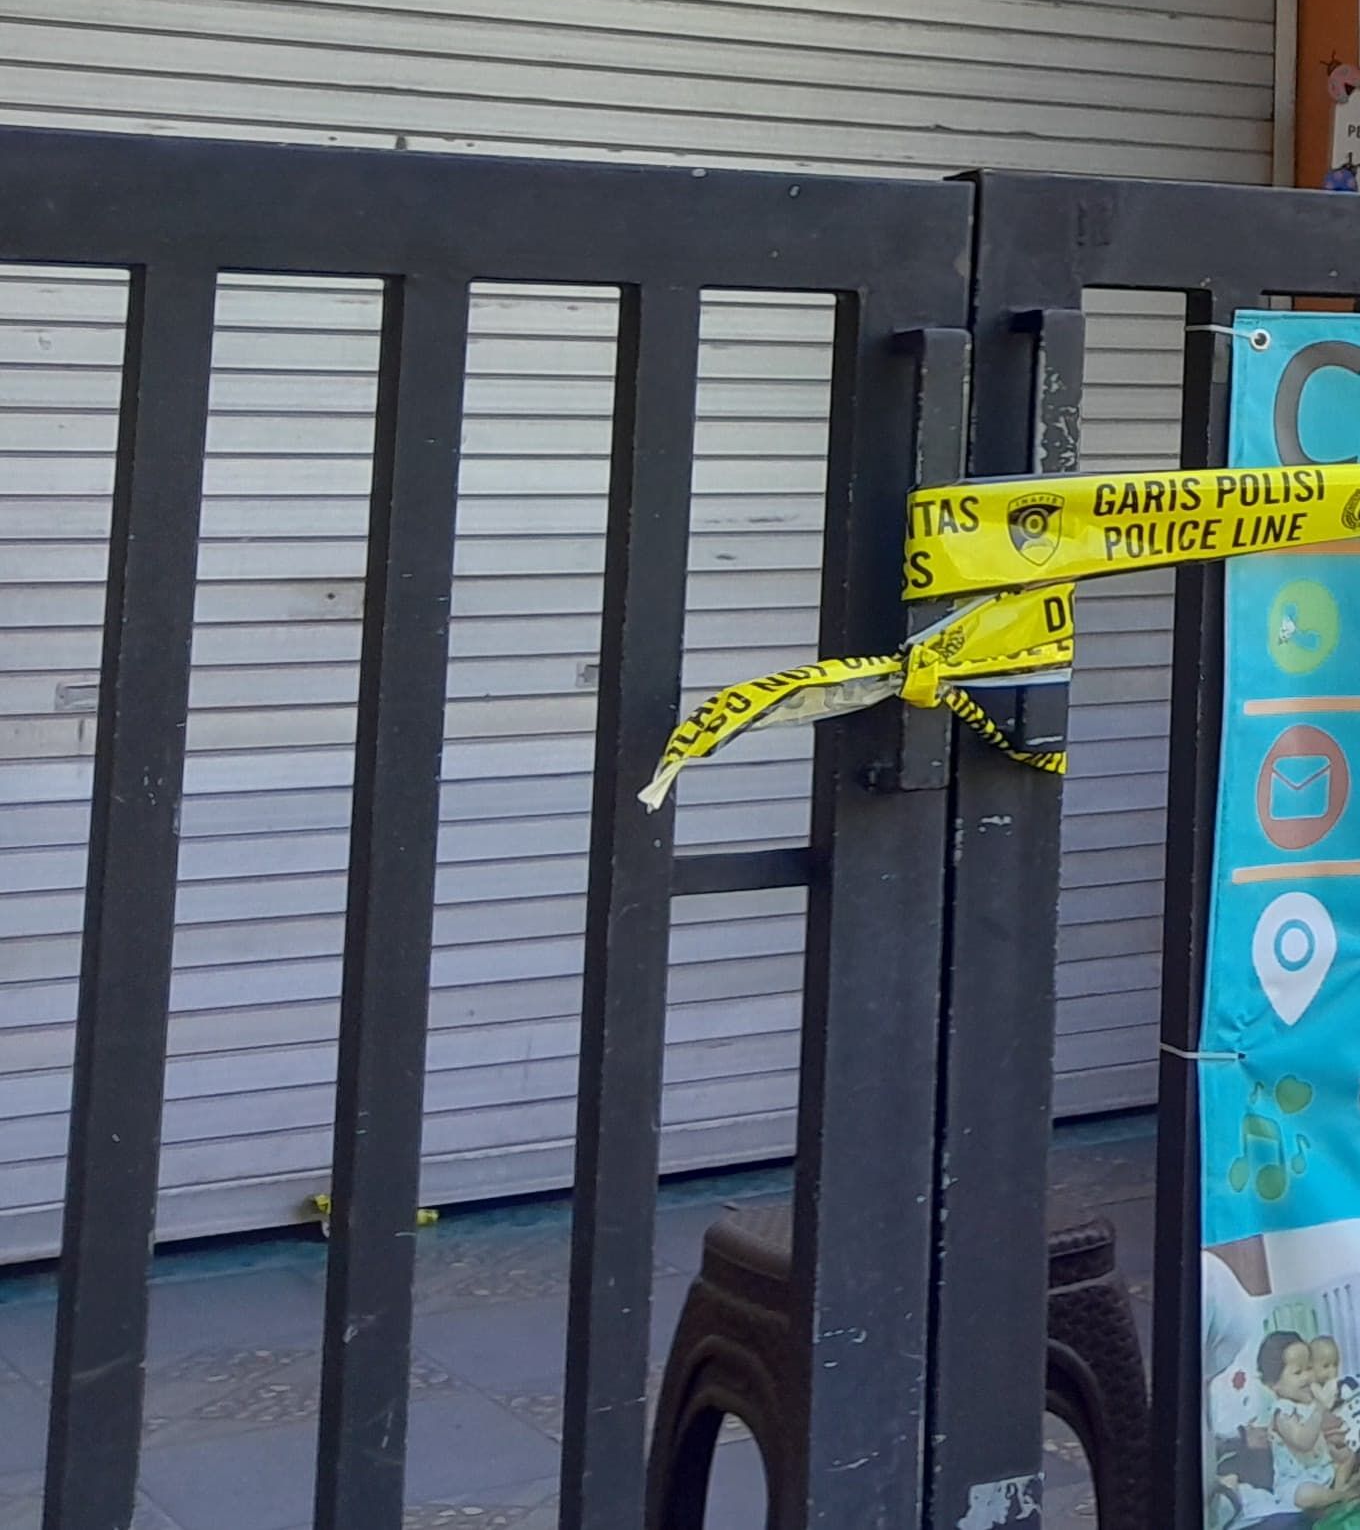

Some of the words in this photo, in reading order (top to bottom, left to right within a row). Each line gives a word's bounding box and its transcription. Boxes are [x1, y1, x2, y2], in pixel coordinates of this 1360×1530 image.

[1093, 477, 1202, 517] GARIS
[1215, 469, 1326, 509] POLISI
[1104, 519, 1222, 561] POLICE
[1231, 512, 1308, 548] LINE
